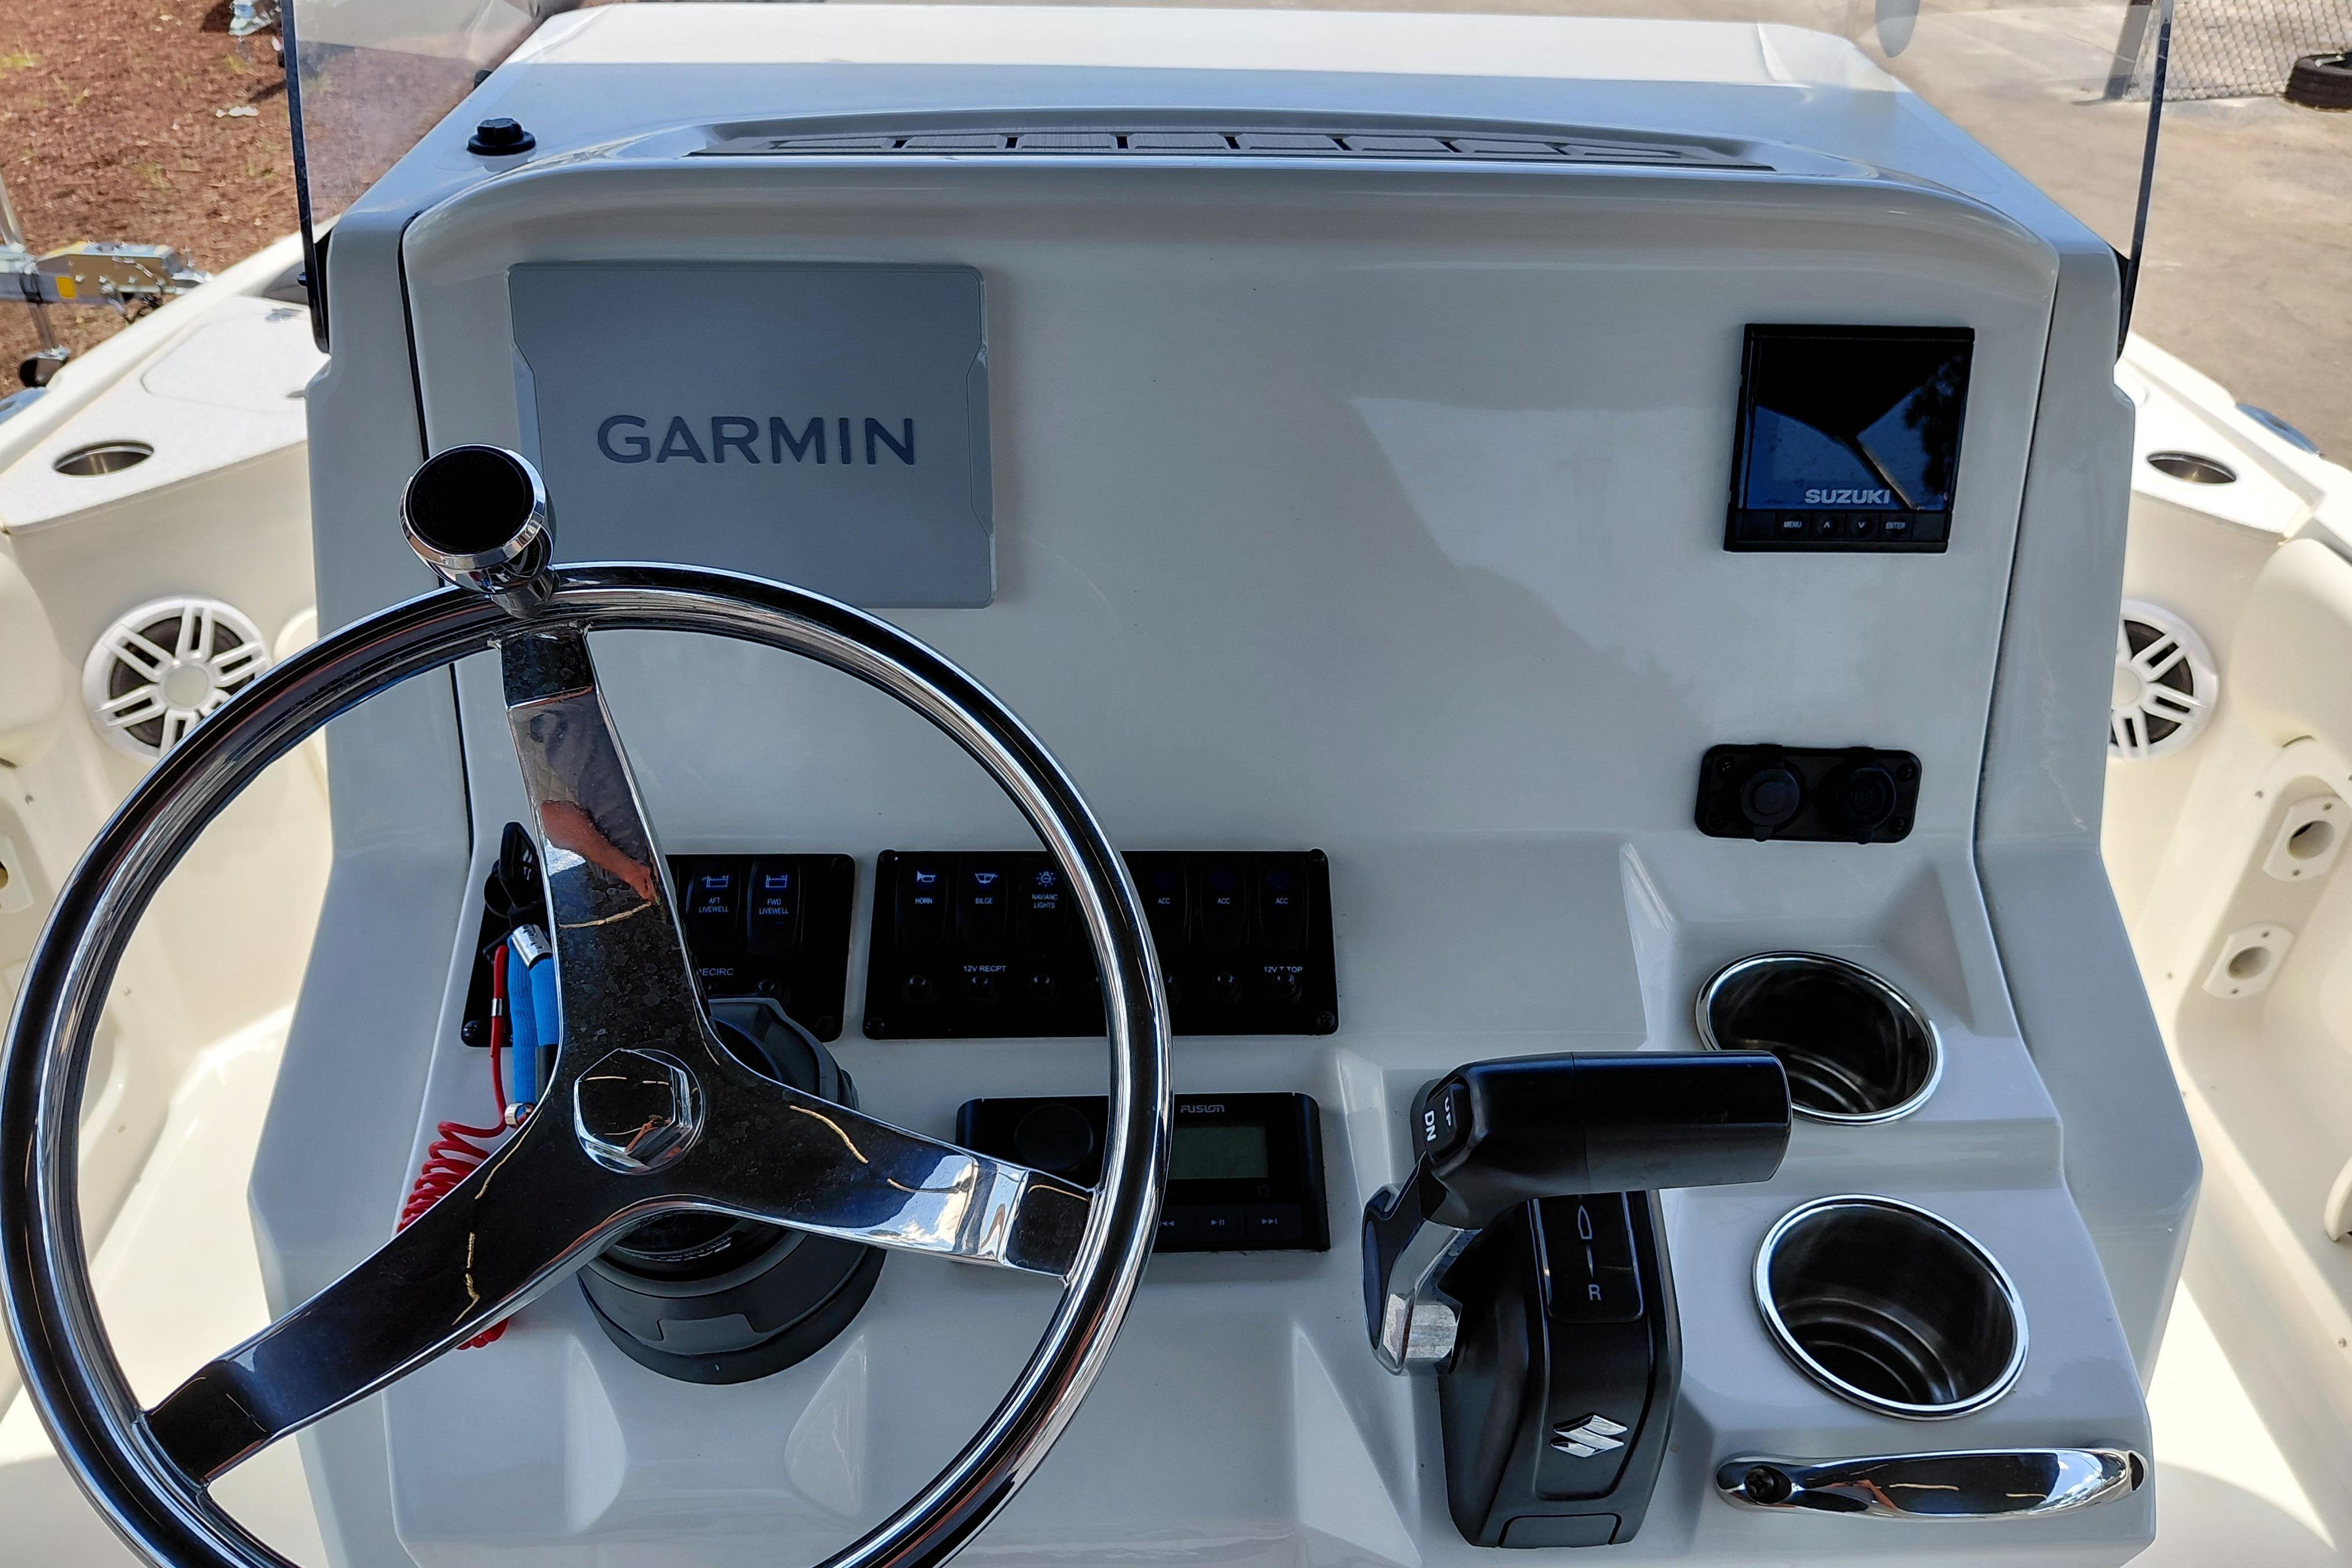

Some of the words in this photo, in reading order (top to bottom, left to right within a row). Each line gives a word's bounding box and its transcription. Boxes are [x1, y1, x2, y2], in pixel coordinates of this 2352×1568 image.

[597, 414, 915, 465] GARMIN
[1804, 489, 1891, 504] SUZUKI
[1783, 521, 1802, 529] MENU
[1885, 521, 1906, 530] ENTER
[1180, 1104, 1226, 1113] FUSION
[1424, 1110, 1437, 1141] DN
[1588, 1284, 1602, 1301] R
